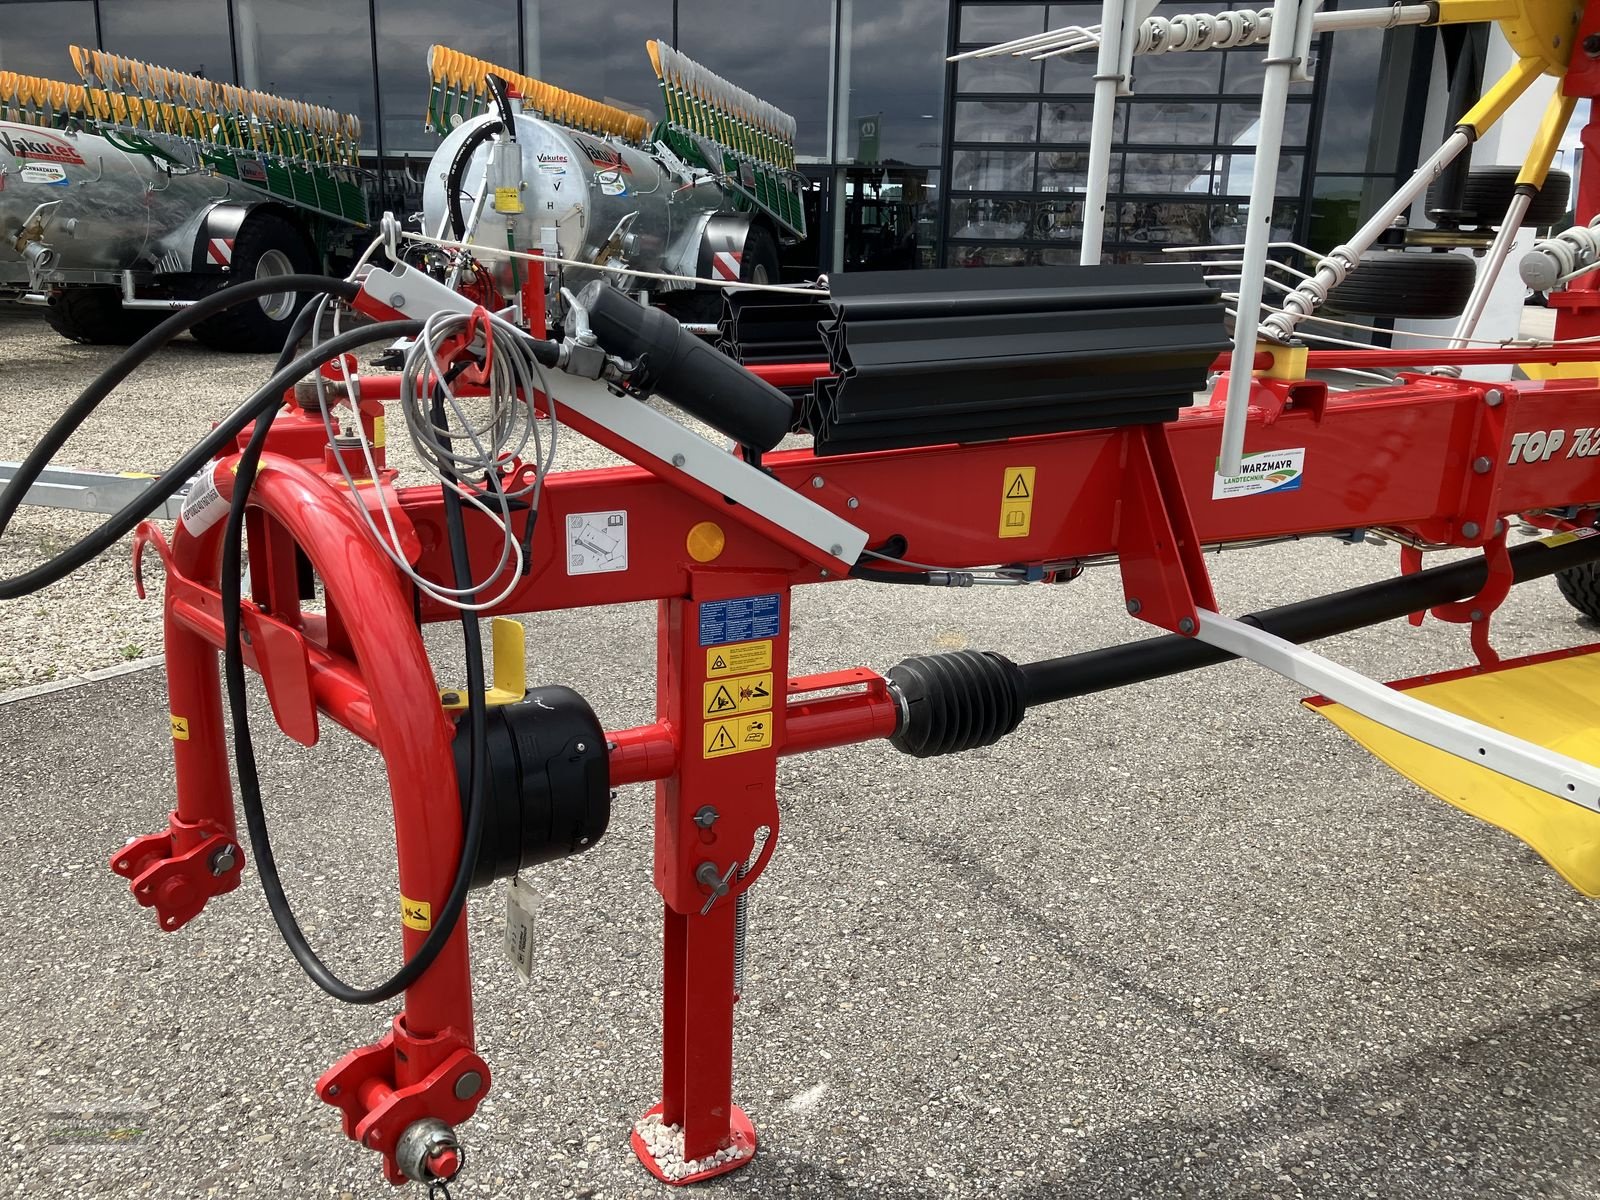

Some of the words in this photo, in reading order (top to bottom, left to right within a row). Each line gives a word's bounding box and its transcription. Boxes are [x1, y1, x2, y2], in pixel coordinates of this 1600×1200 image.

[0, 131, 82, 158] Vakutec
[537, 153, 568, 162] Vakutec
[547, 201, 554, 210] H
[1507, 430, 1565, 465] TOP
[1223, 474, 1265, 485] LANDTECHNIK
